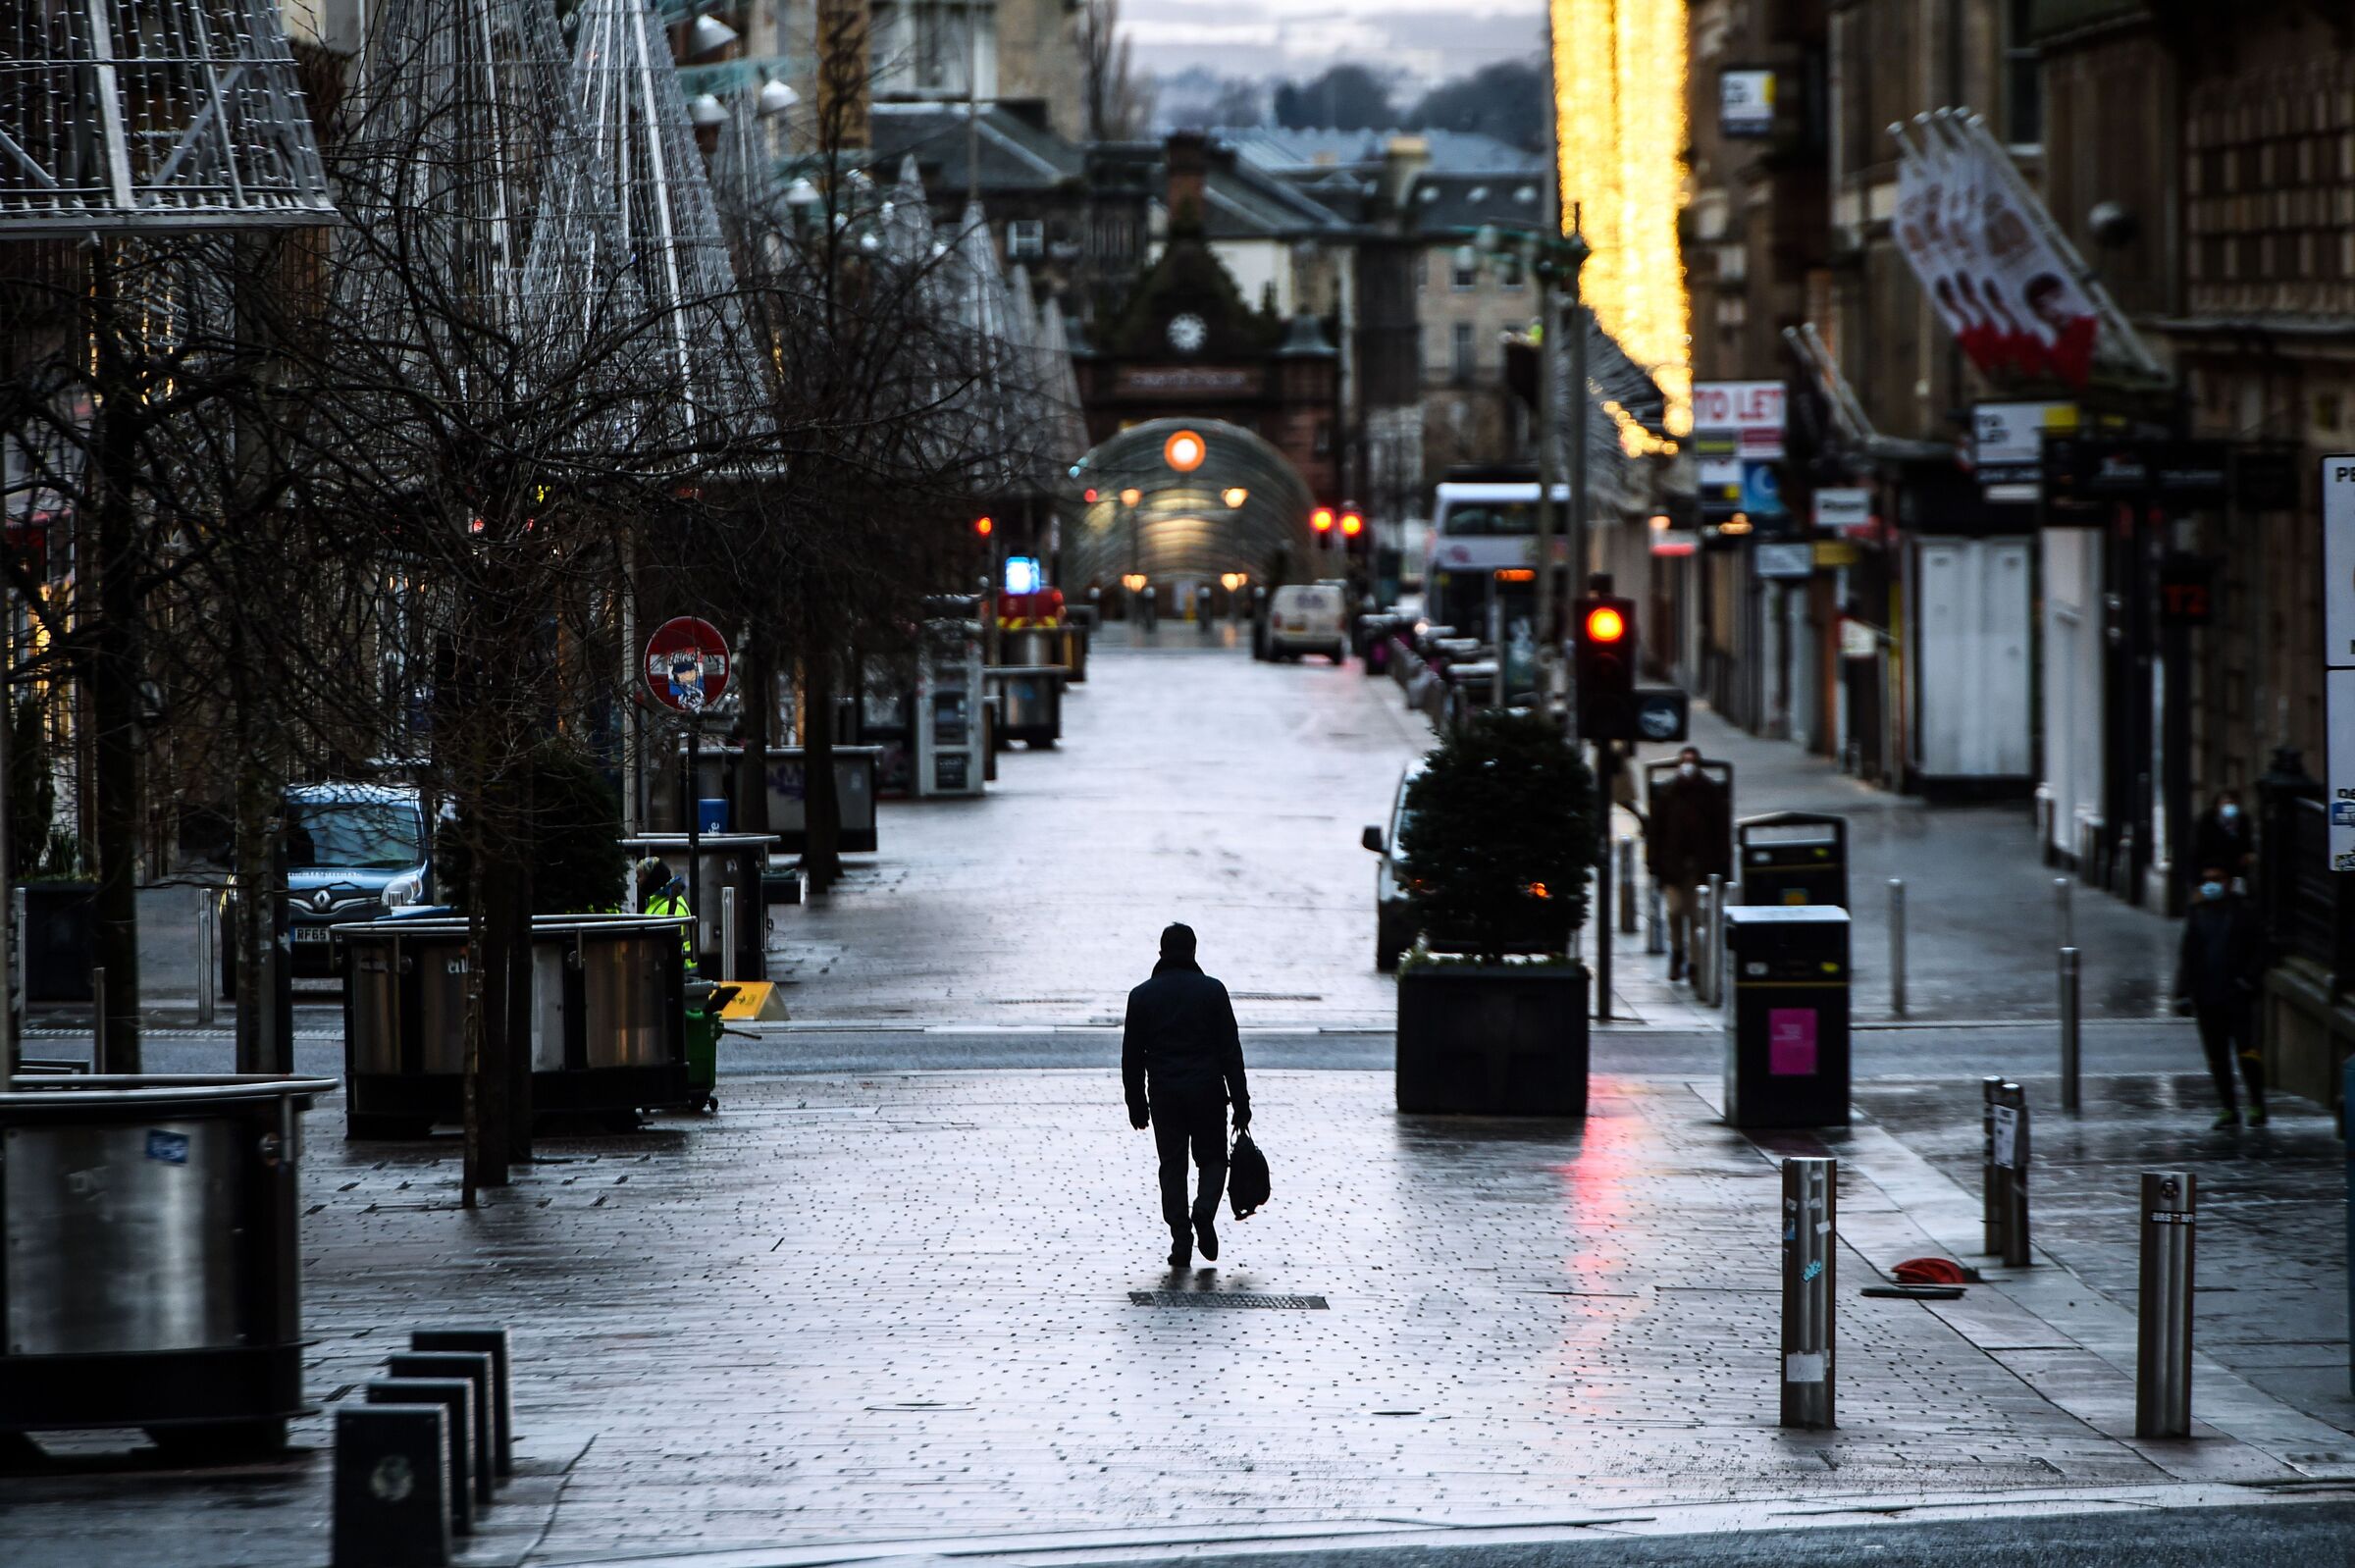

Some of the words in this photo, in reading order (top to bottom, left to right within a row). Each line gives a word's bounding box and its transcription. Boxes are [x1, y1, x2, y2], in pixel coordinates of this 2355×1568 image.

[1694, 389, 1729, 420] TO
[1734, 389, 1783, 420] LET
[296, 928, 327, 940] RF65
